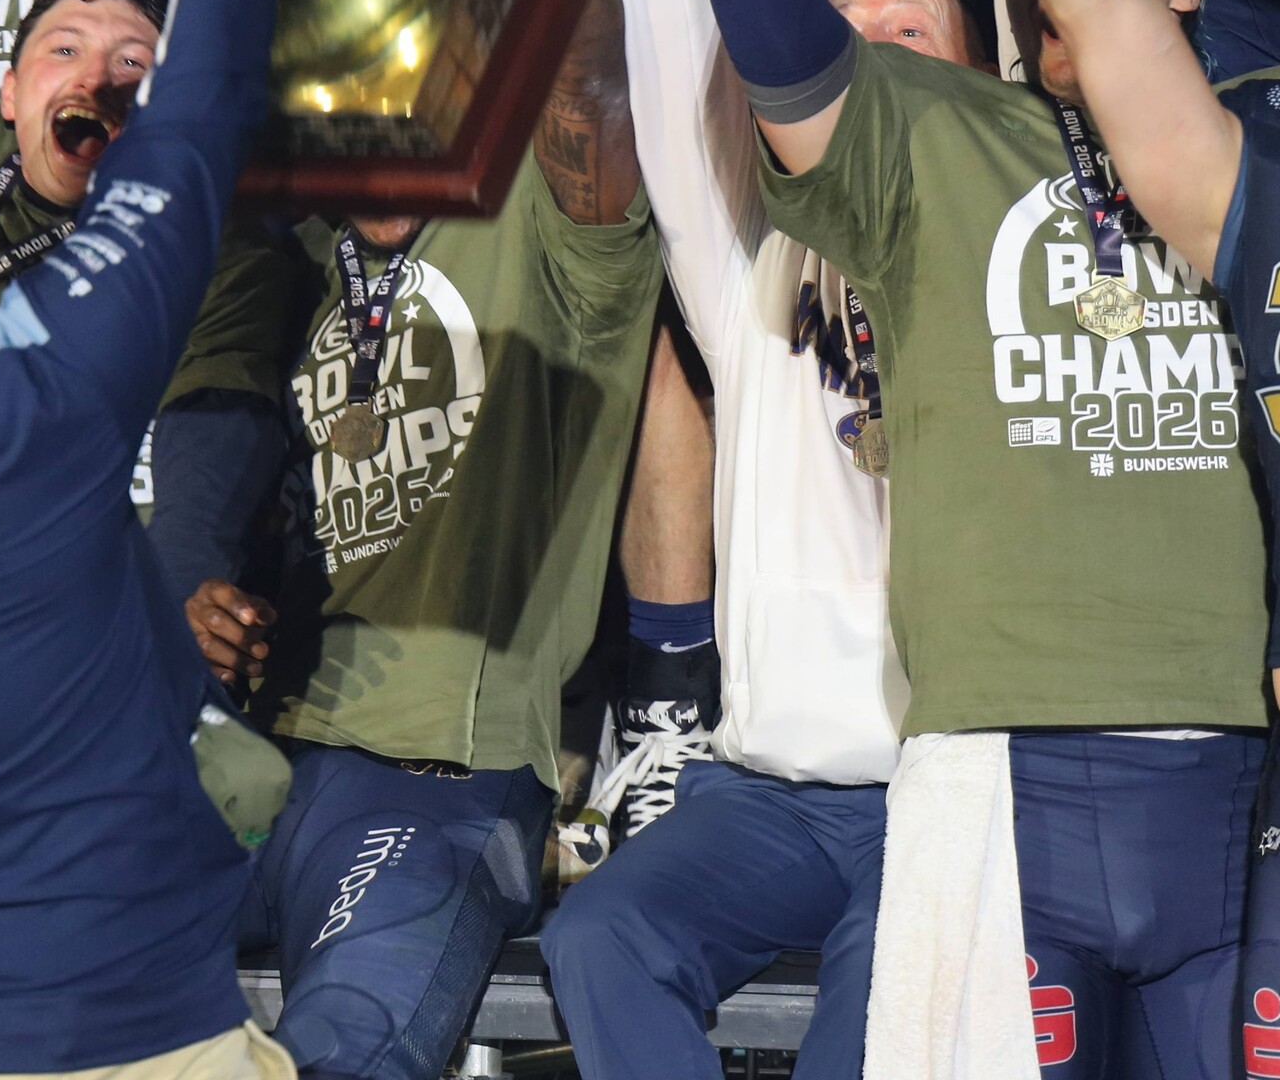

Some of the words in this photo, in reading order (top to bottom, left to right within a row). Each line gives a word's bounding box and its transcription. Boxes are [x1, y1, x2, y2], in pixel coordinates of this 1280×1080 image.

[1061, 109, 1080, 143] BOWL
[1072, 145, 1096, 179] 2026
[349, 276, 366, 308] 2026
[377, 271, 395, 296] GFL
[1070, 387, 1240, 452] 2026
[1035, 433, 1058, 443] GFL
[1123, 455, 1229, 473] BUNDESWEHR
